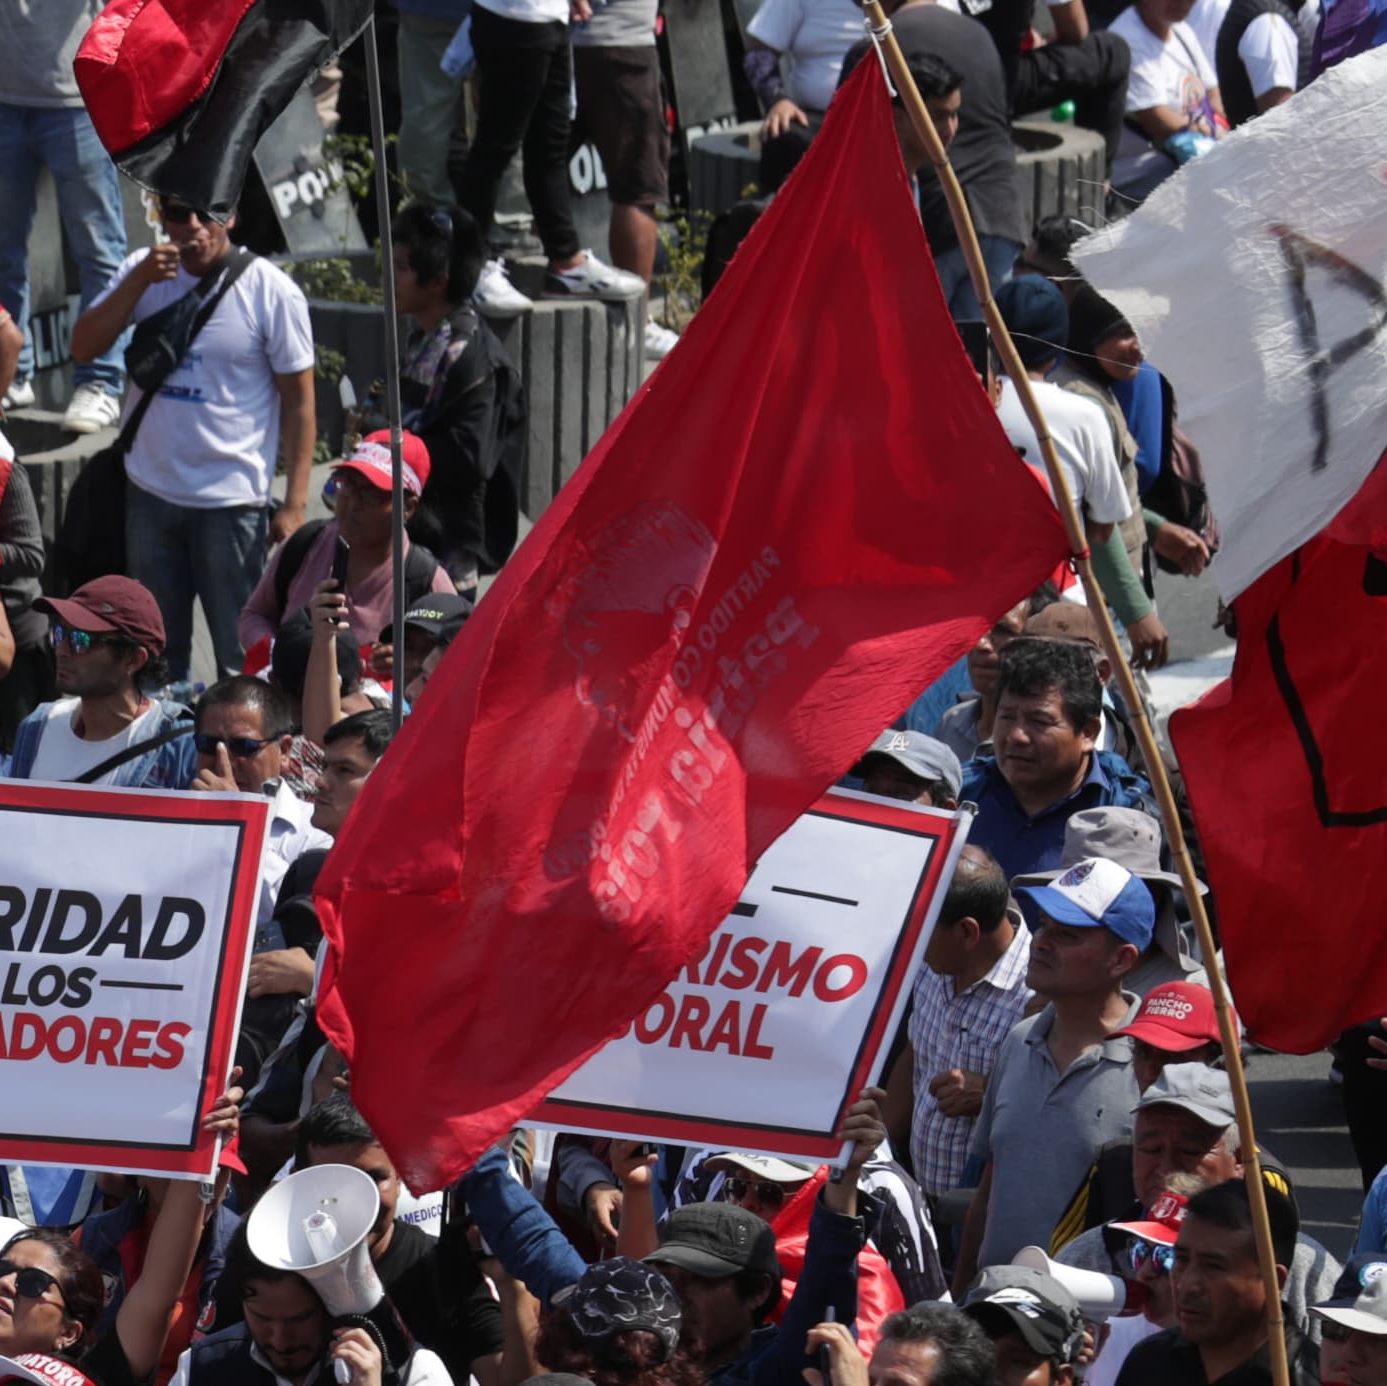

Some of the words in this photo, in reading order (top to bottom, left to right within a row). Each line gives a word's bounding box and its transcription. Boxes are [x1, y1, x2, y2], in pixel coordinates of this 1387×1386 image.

[1, 961, 97, 1008] LOS
[1145, 998, 1193, 1014] PANCHO
[1145, 1006, 1186, 1020] FIERRO
